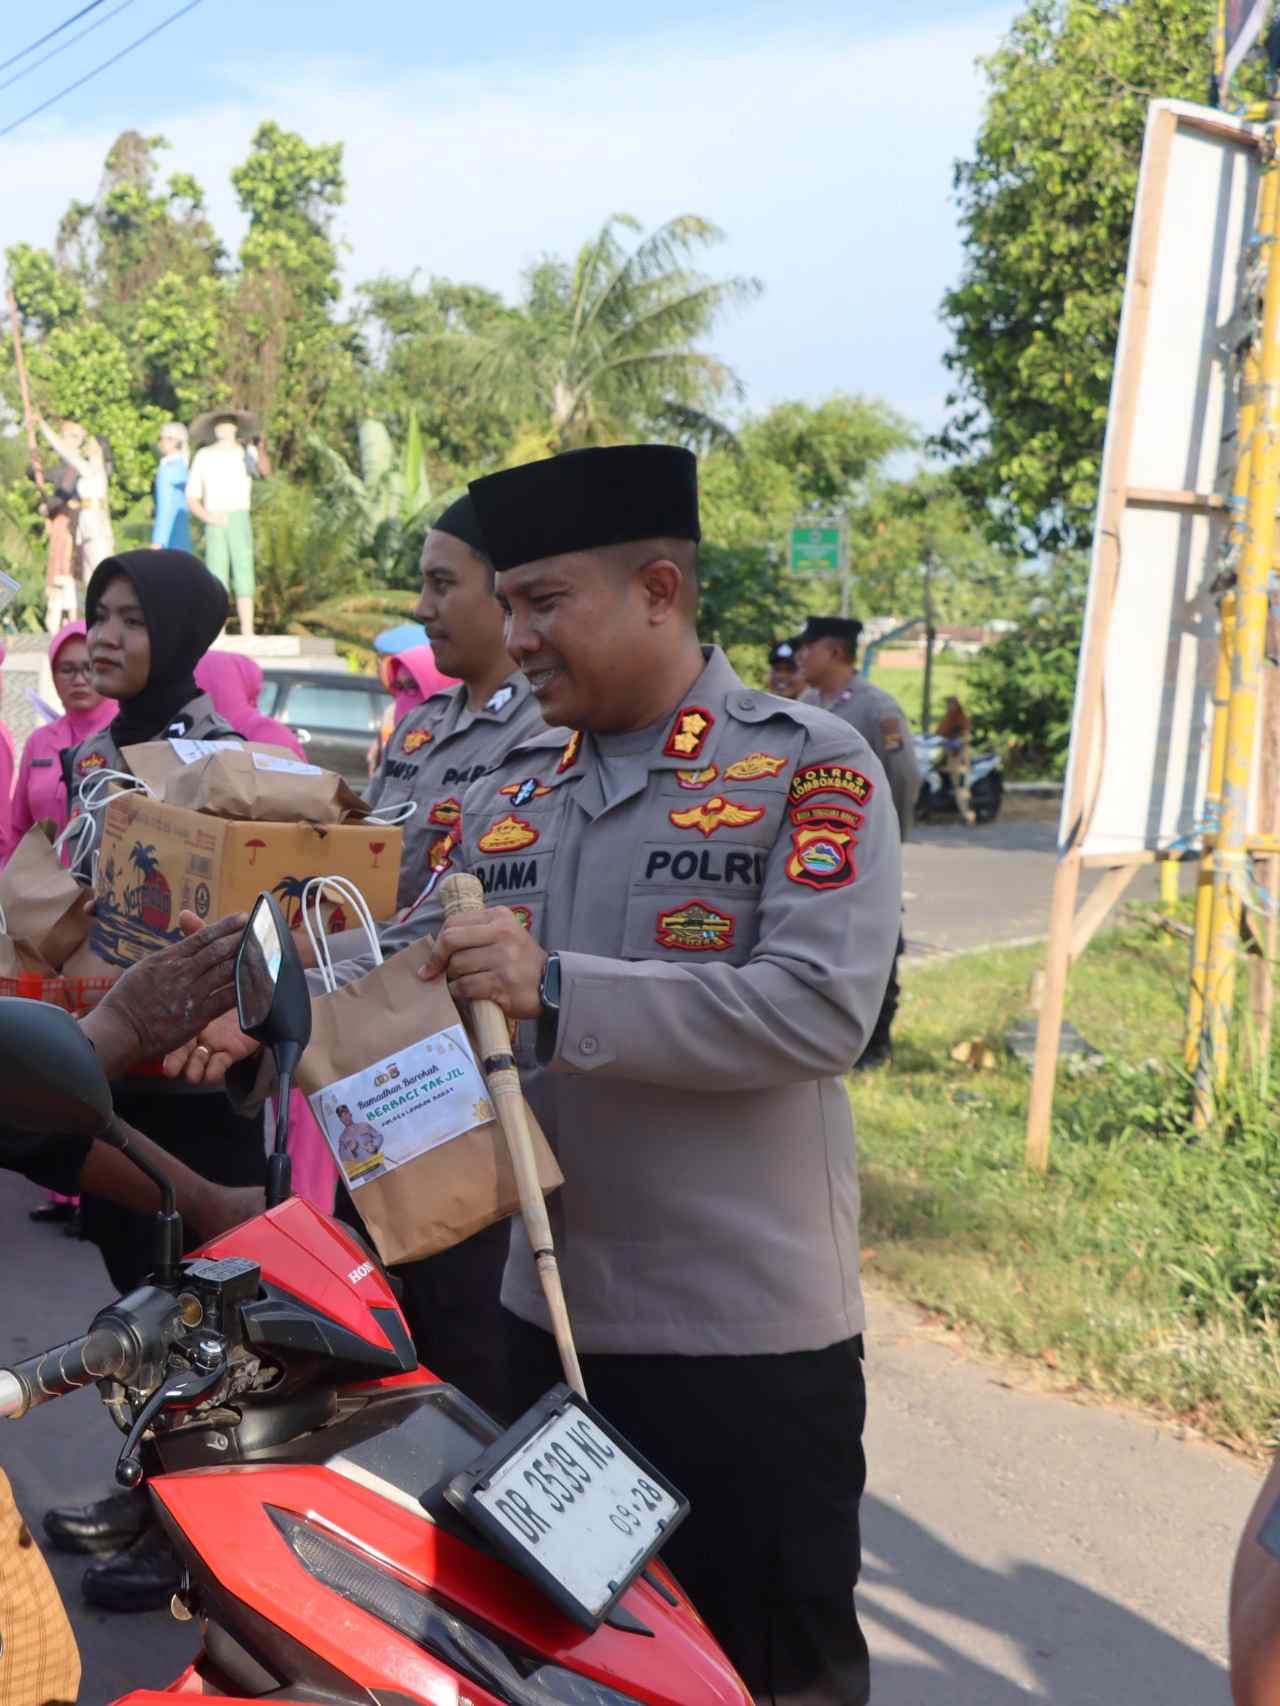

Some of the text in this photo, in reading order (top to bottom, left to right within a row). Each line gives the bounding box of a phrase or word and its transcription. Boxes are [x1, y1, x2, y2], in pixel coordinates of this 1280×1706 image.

[793, 768, 865, 788] POLRES
[645, 850, 763, 885] POLRI
[356, 1081, 402, 1110] Ramadhan
[366, 1088, 418, 1121] BERBAGI
[523, 1442, 592, 1513] 3539
[495, 1488, 552, 1544] DR
